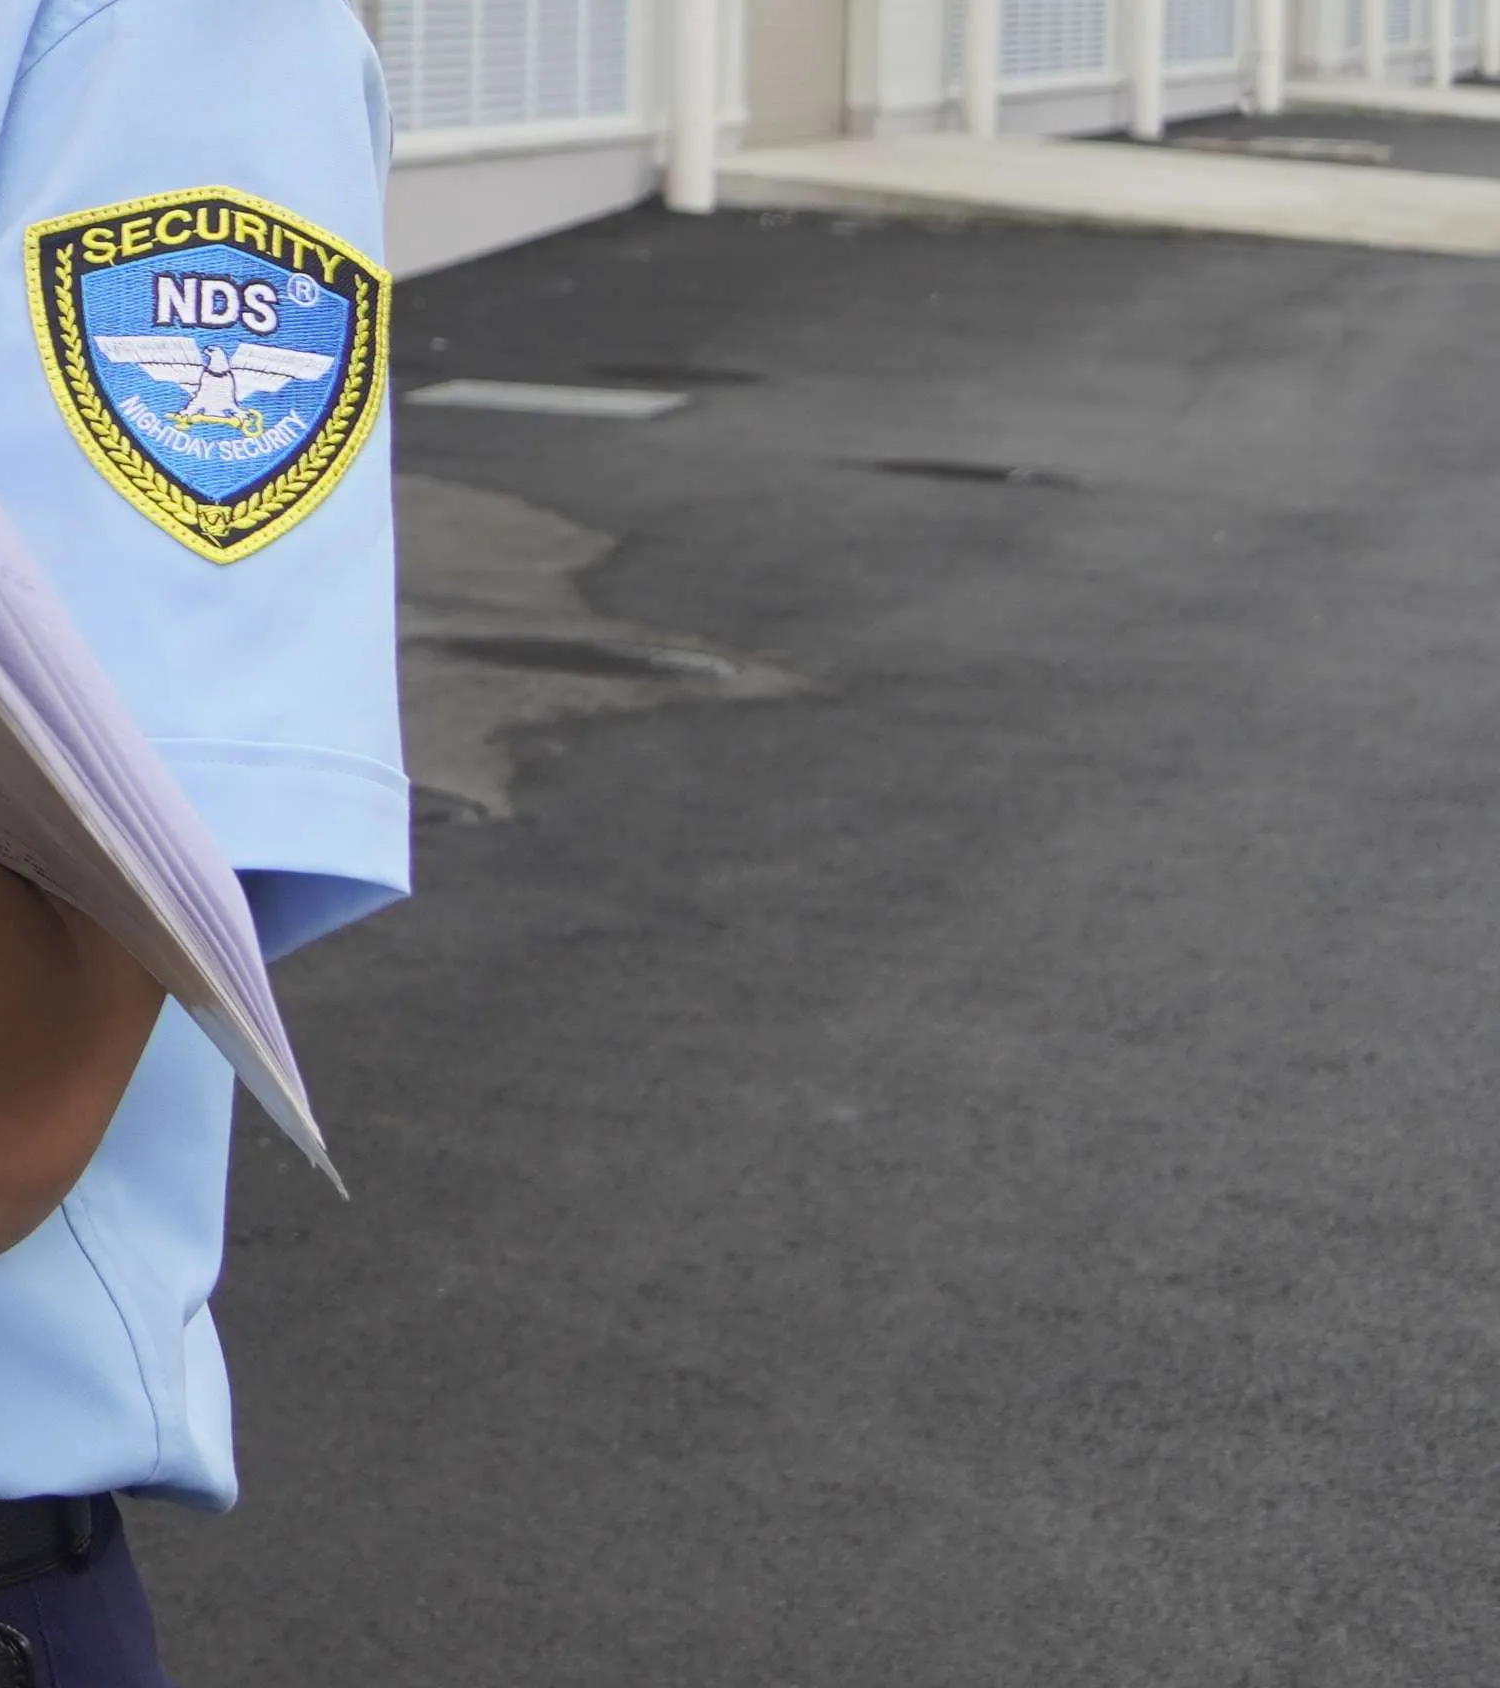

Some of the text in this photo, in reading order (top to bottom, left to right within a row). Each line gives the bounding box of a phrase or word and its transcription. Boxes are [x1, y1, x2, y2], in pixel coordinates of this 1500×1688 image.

[79, 206, 347, 285] SECURITY
[156, 275, 280, 335] NDS
[118, 393, 309, 462] NIGHTDAY SECURITY
